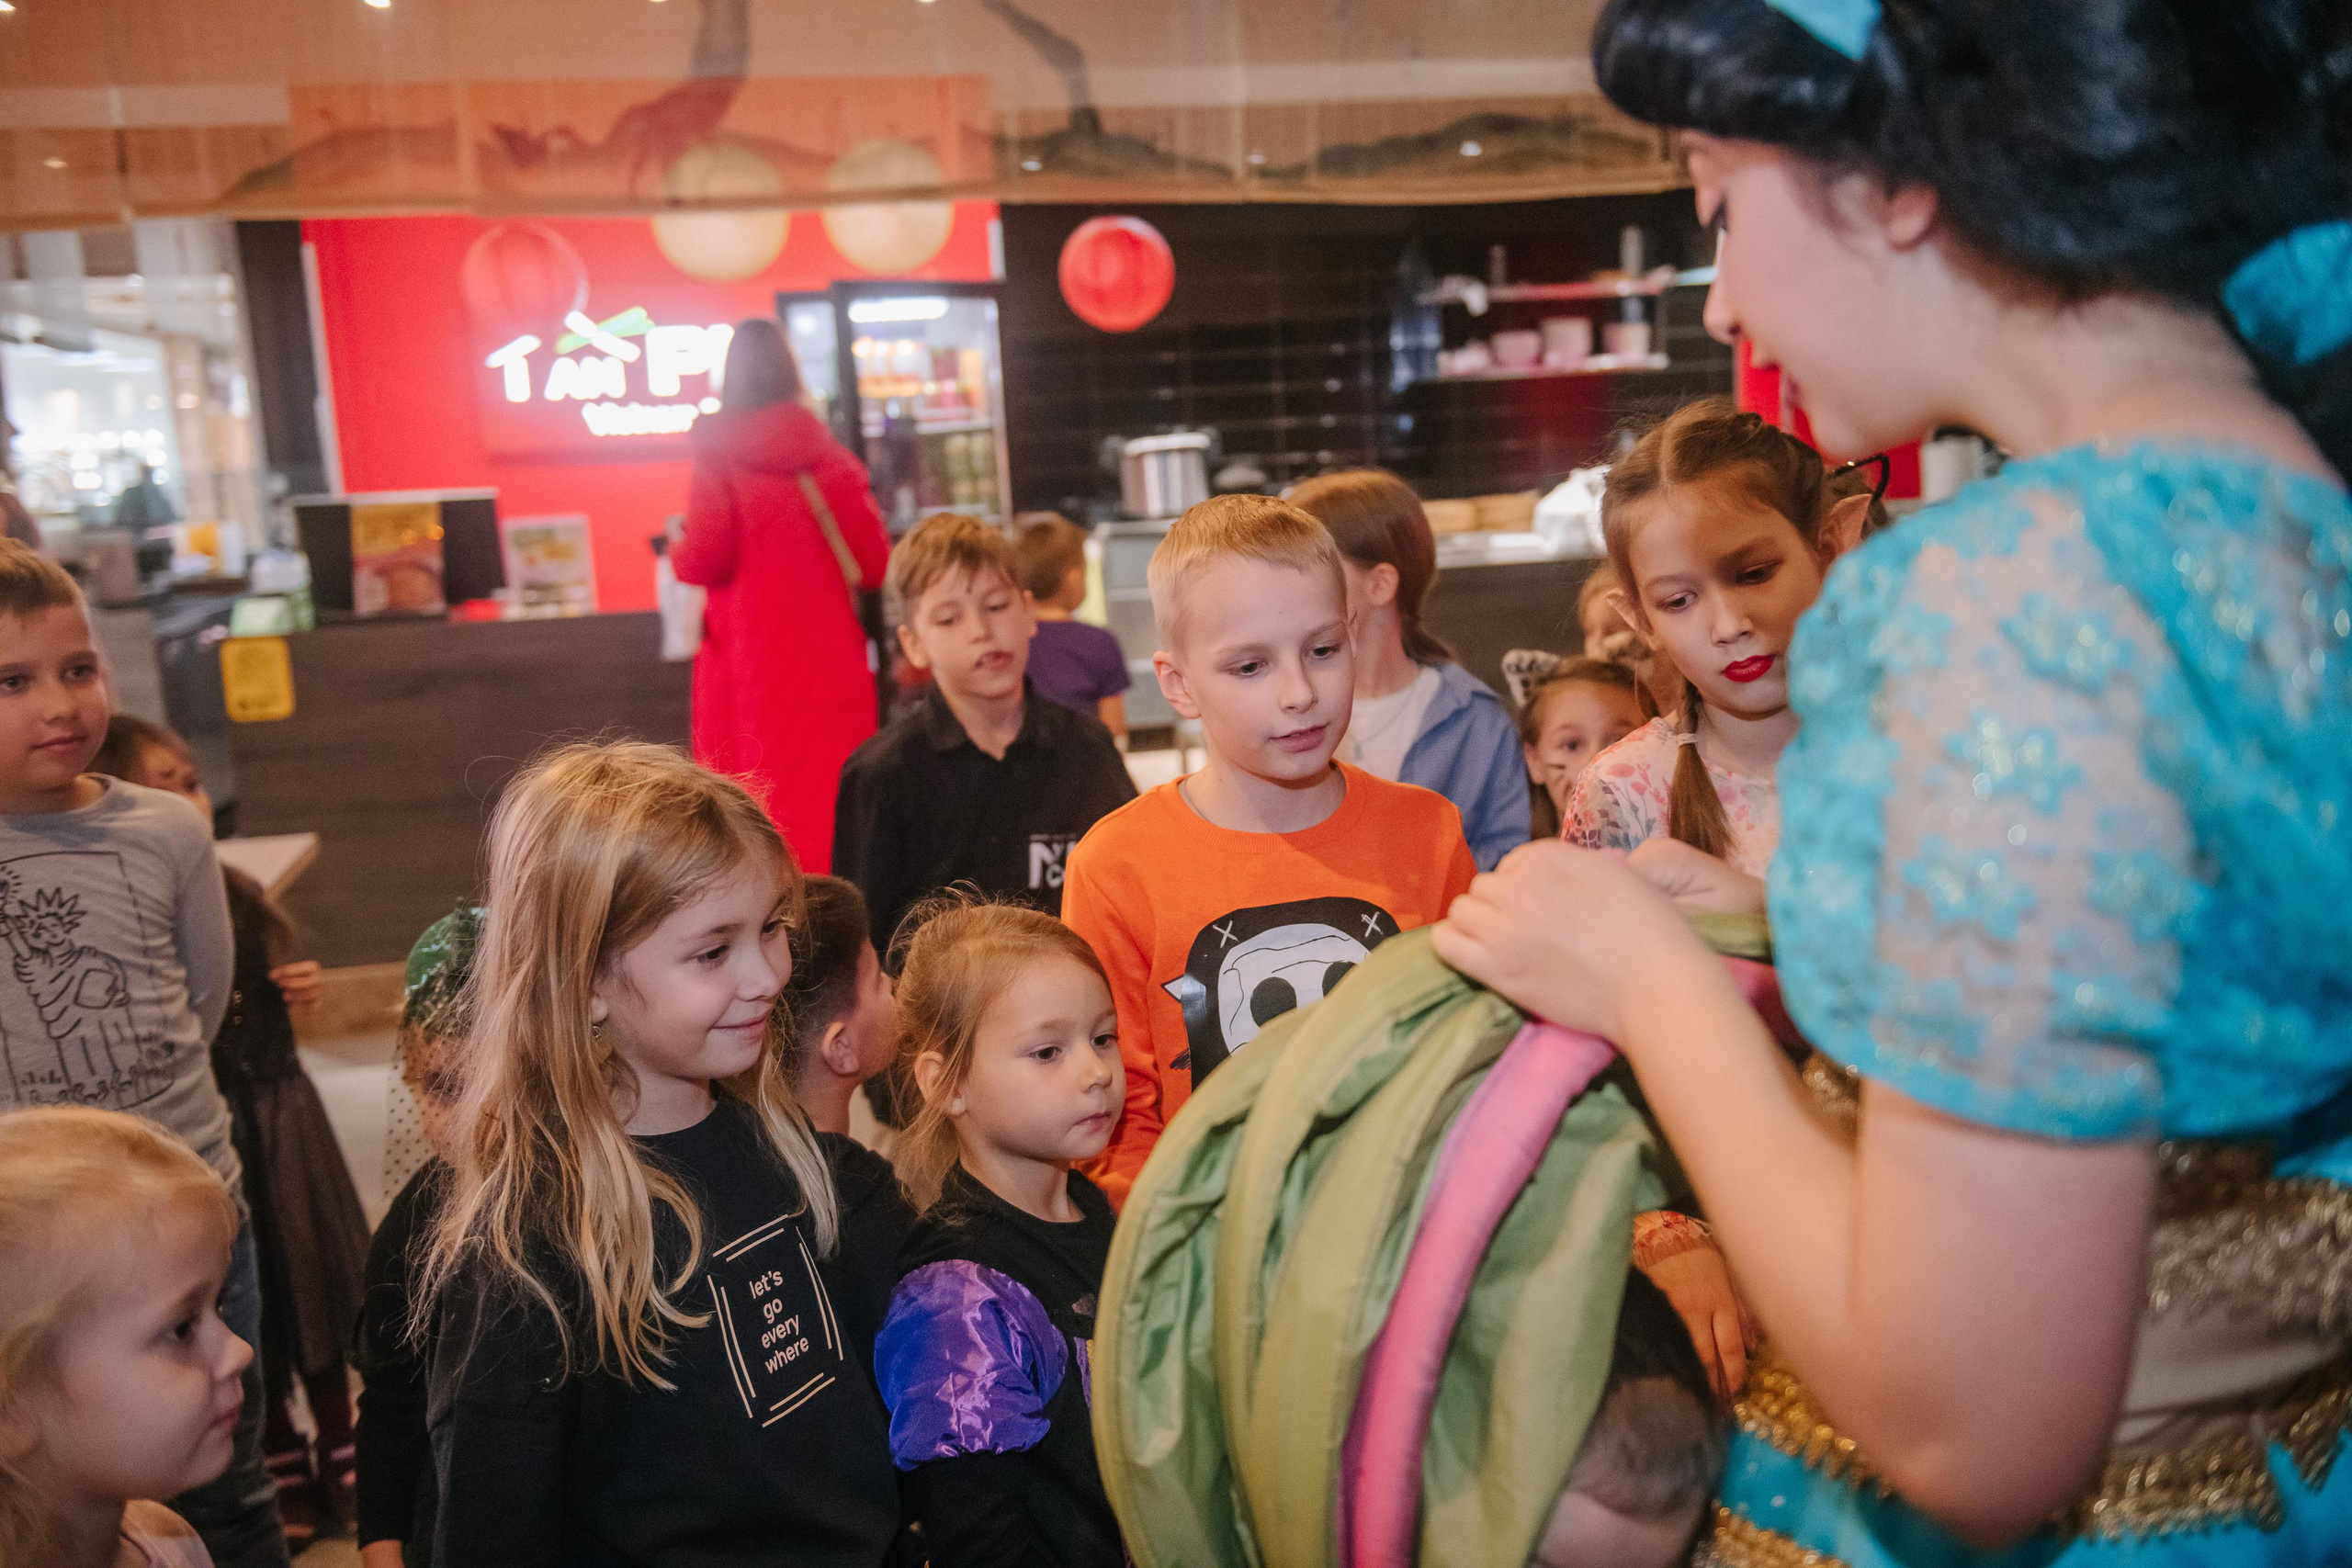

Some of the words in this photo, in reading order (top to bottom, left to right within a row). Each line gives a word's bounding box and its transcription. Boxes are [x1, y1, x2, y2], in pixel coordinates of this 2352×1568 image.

[749, 1269, 784, 1300] let's
[763, 1298, 784, 1325] go
[761, 1314, 800, 1349] every
[764, 1337, 809, 1374] where
